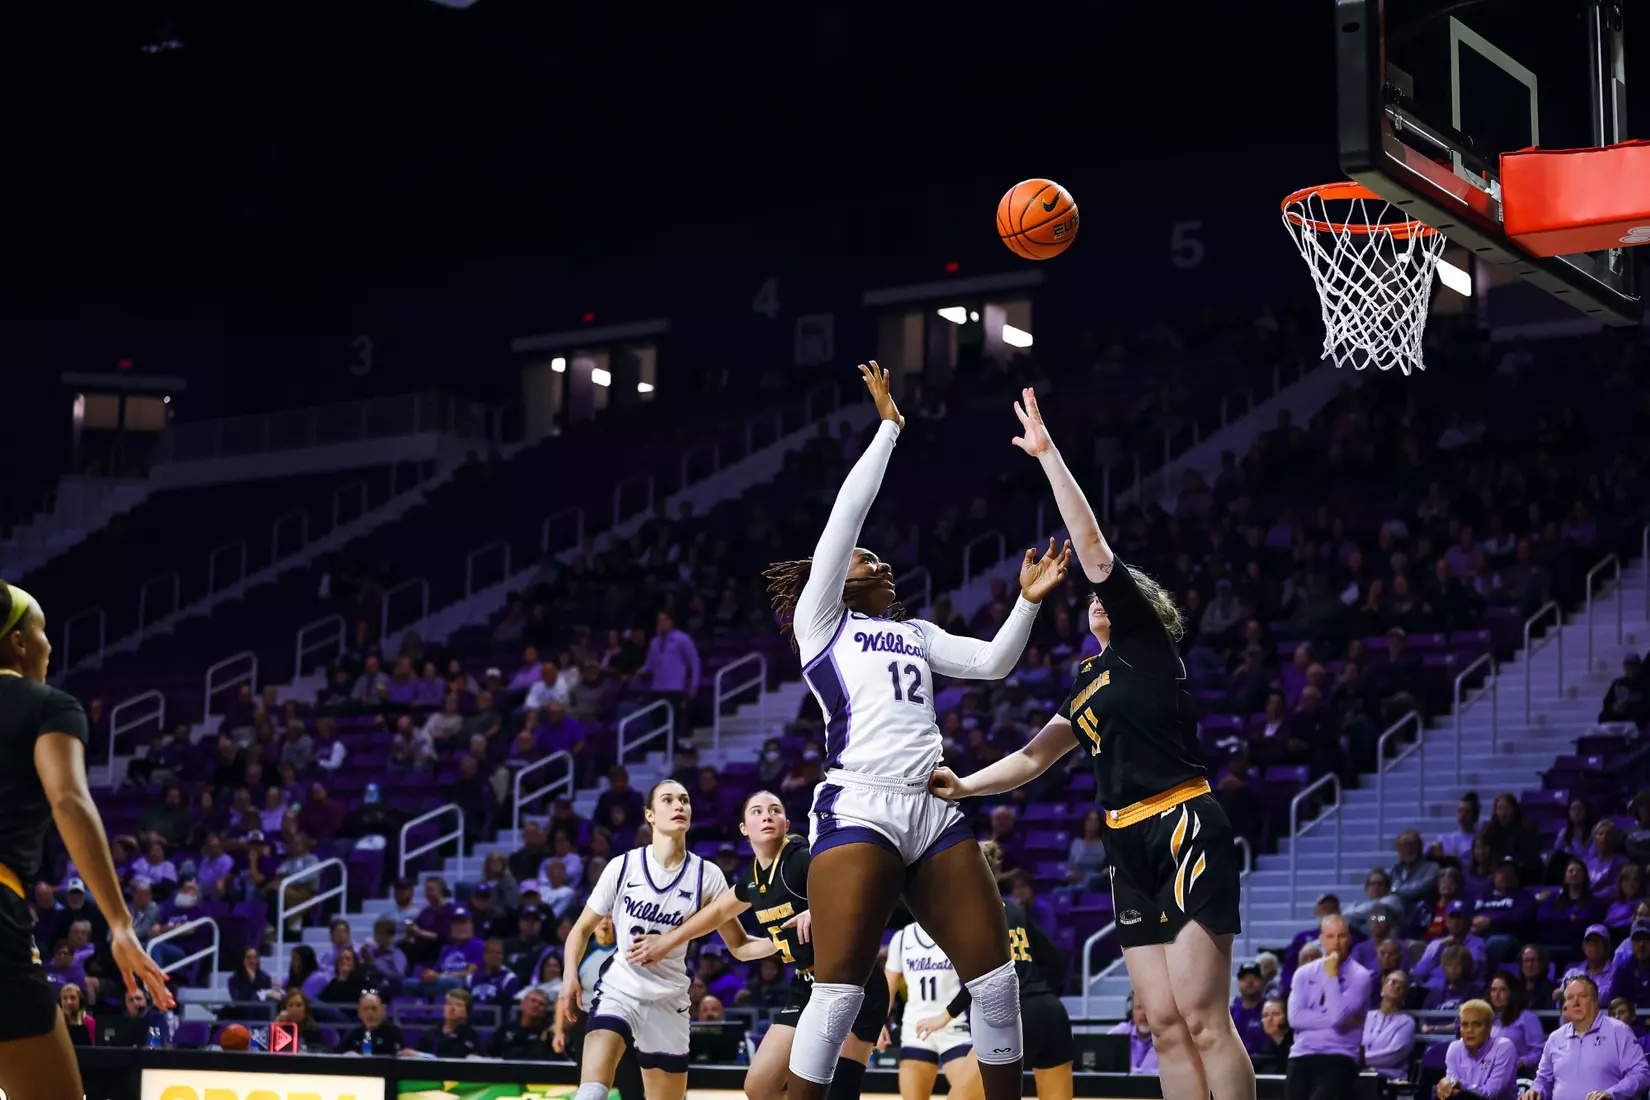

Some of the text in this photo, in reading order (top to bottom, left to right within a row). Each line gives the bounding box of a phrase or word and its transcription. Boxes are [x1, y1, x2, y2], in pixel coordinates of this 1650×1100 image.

[1169, 218, 1206, 270] 5
[751, 276, 784, 320] 4
[349, 333, 374, 376] 3
[887, 660, 925, 705] 12
[624, 895, 684, 927] Wildcats
[767, 925, 796, 963] 5
[906, 957, 953, 972] Wildcats
[919, 975, 937, 1001] 11
